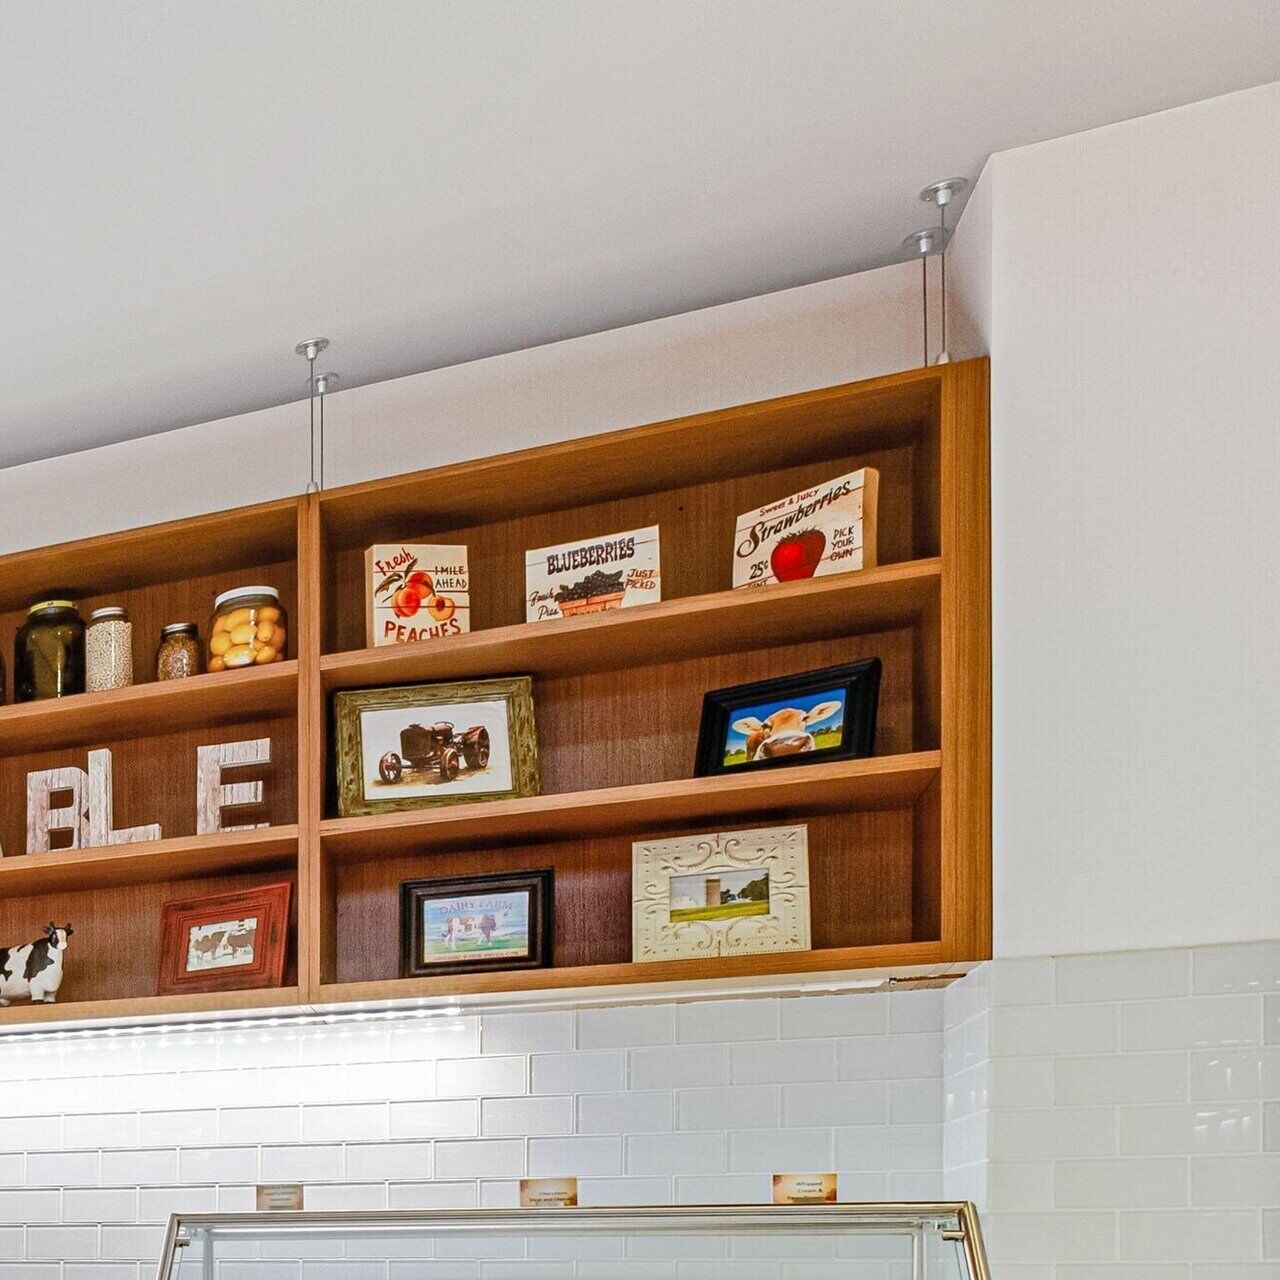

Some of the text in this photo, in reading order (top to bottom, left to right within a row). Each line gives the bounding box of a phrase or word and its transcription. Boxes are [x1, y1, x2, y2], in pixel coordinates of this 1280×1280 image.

[788, 495, 795, 506] &
[736, 481, 851, 558] Strawberries
[834, 526, 854, 540] PICK
[831, 536, 854, 550] YOUR
[375, 547, 415, 577] Fresh
[547, 537, 635, 575] BLUEBERRIES
[830, 548, 854, 562] OWN
[441, 566, 466, 575] MILE
[627, 569, 655, 578] JUST
[435, 579, 467, 589] AHEAD
[625, 579, 656, 590] PICKED
[384, 618, 462, 642] PEACHES
[440, 899, 513, 915] DAIRY FARM
